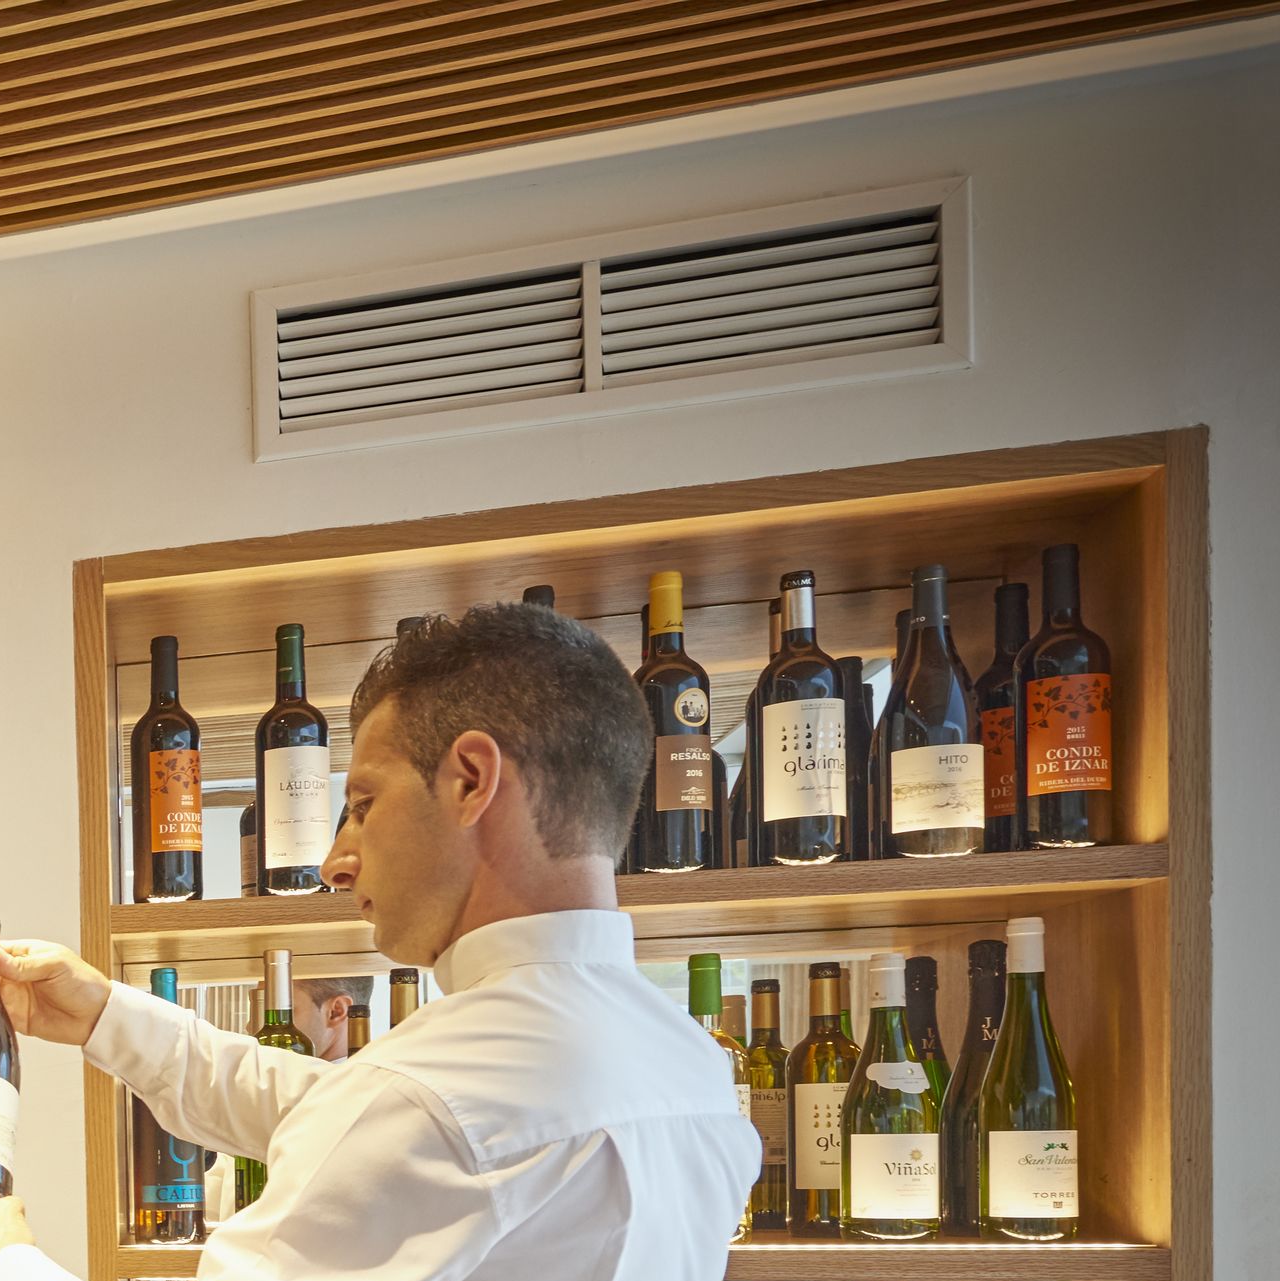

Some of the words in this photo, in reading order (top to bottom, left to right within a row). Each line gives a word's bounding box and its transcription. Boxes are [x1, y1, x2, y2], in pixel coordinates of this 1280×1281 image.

[670, 752, 710, 761] RESALSO
[1046, 746, 1102, 760] CONDE
[938, 755, 969, 765] HITO
[1036, 761, 1060, 775] DE
[1064, 759, 1109, 771] IZNAR
[160, 823, 178, 834] DE
